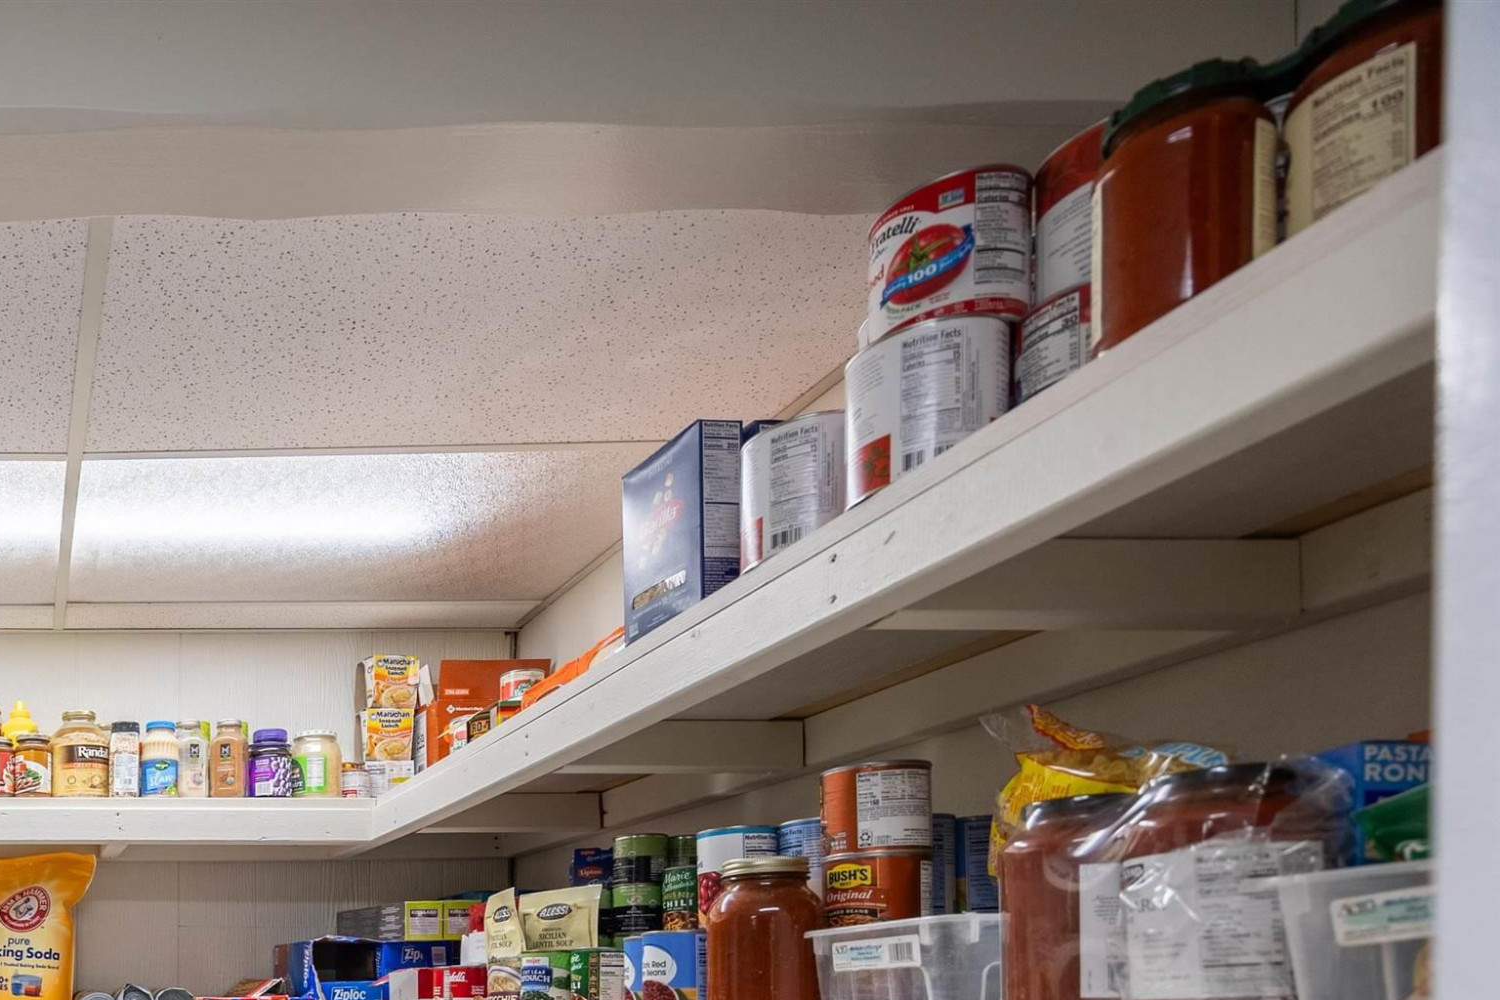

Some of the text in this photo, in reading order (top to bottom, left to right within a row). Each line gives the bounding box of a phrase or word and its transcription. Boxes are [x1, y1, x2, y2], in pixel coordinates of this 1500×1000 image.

[908, 263, 938, 284] 100
[940, 328, 962, 339] Facts
[382, 657, 416, 667] Maruchan
[375, 710, 411, 719] Maruchan
[828, 868, 868, 885] BUSH'S
[827, 889, 873, 903] Original
[662, 899, 693, 909] CHILI
[539, 905, 569, 918] ALESSI
[538, 932, 567, 940] SICILIAN
[8, 937, 30, 947] pure
[25, 947, 60, 961] Soda
